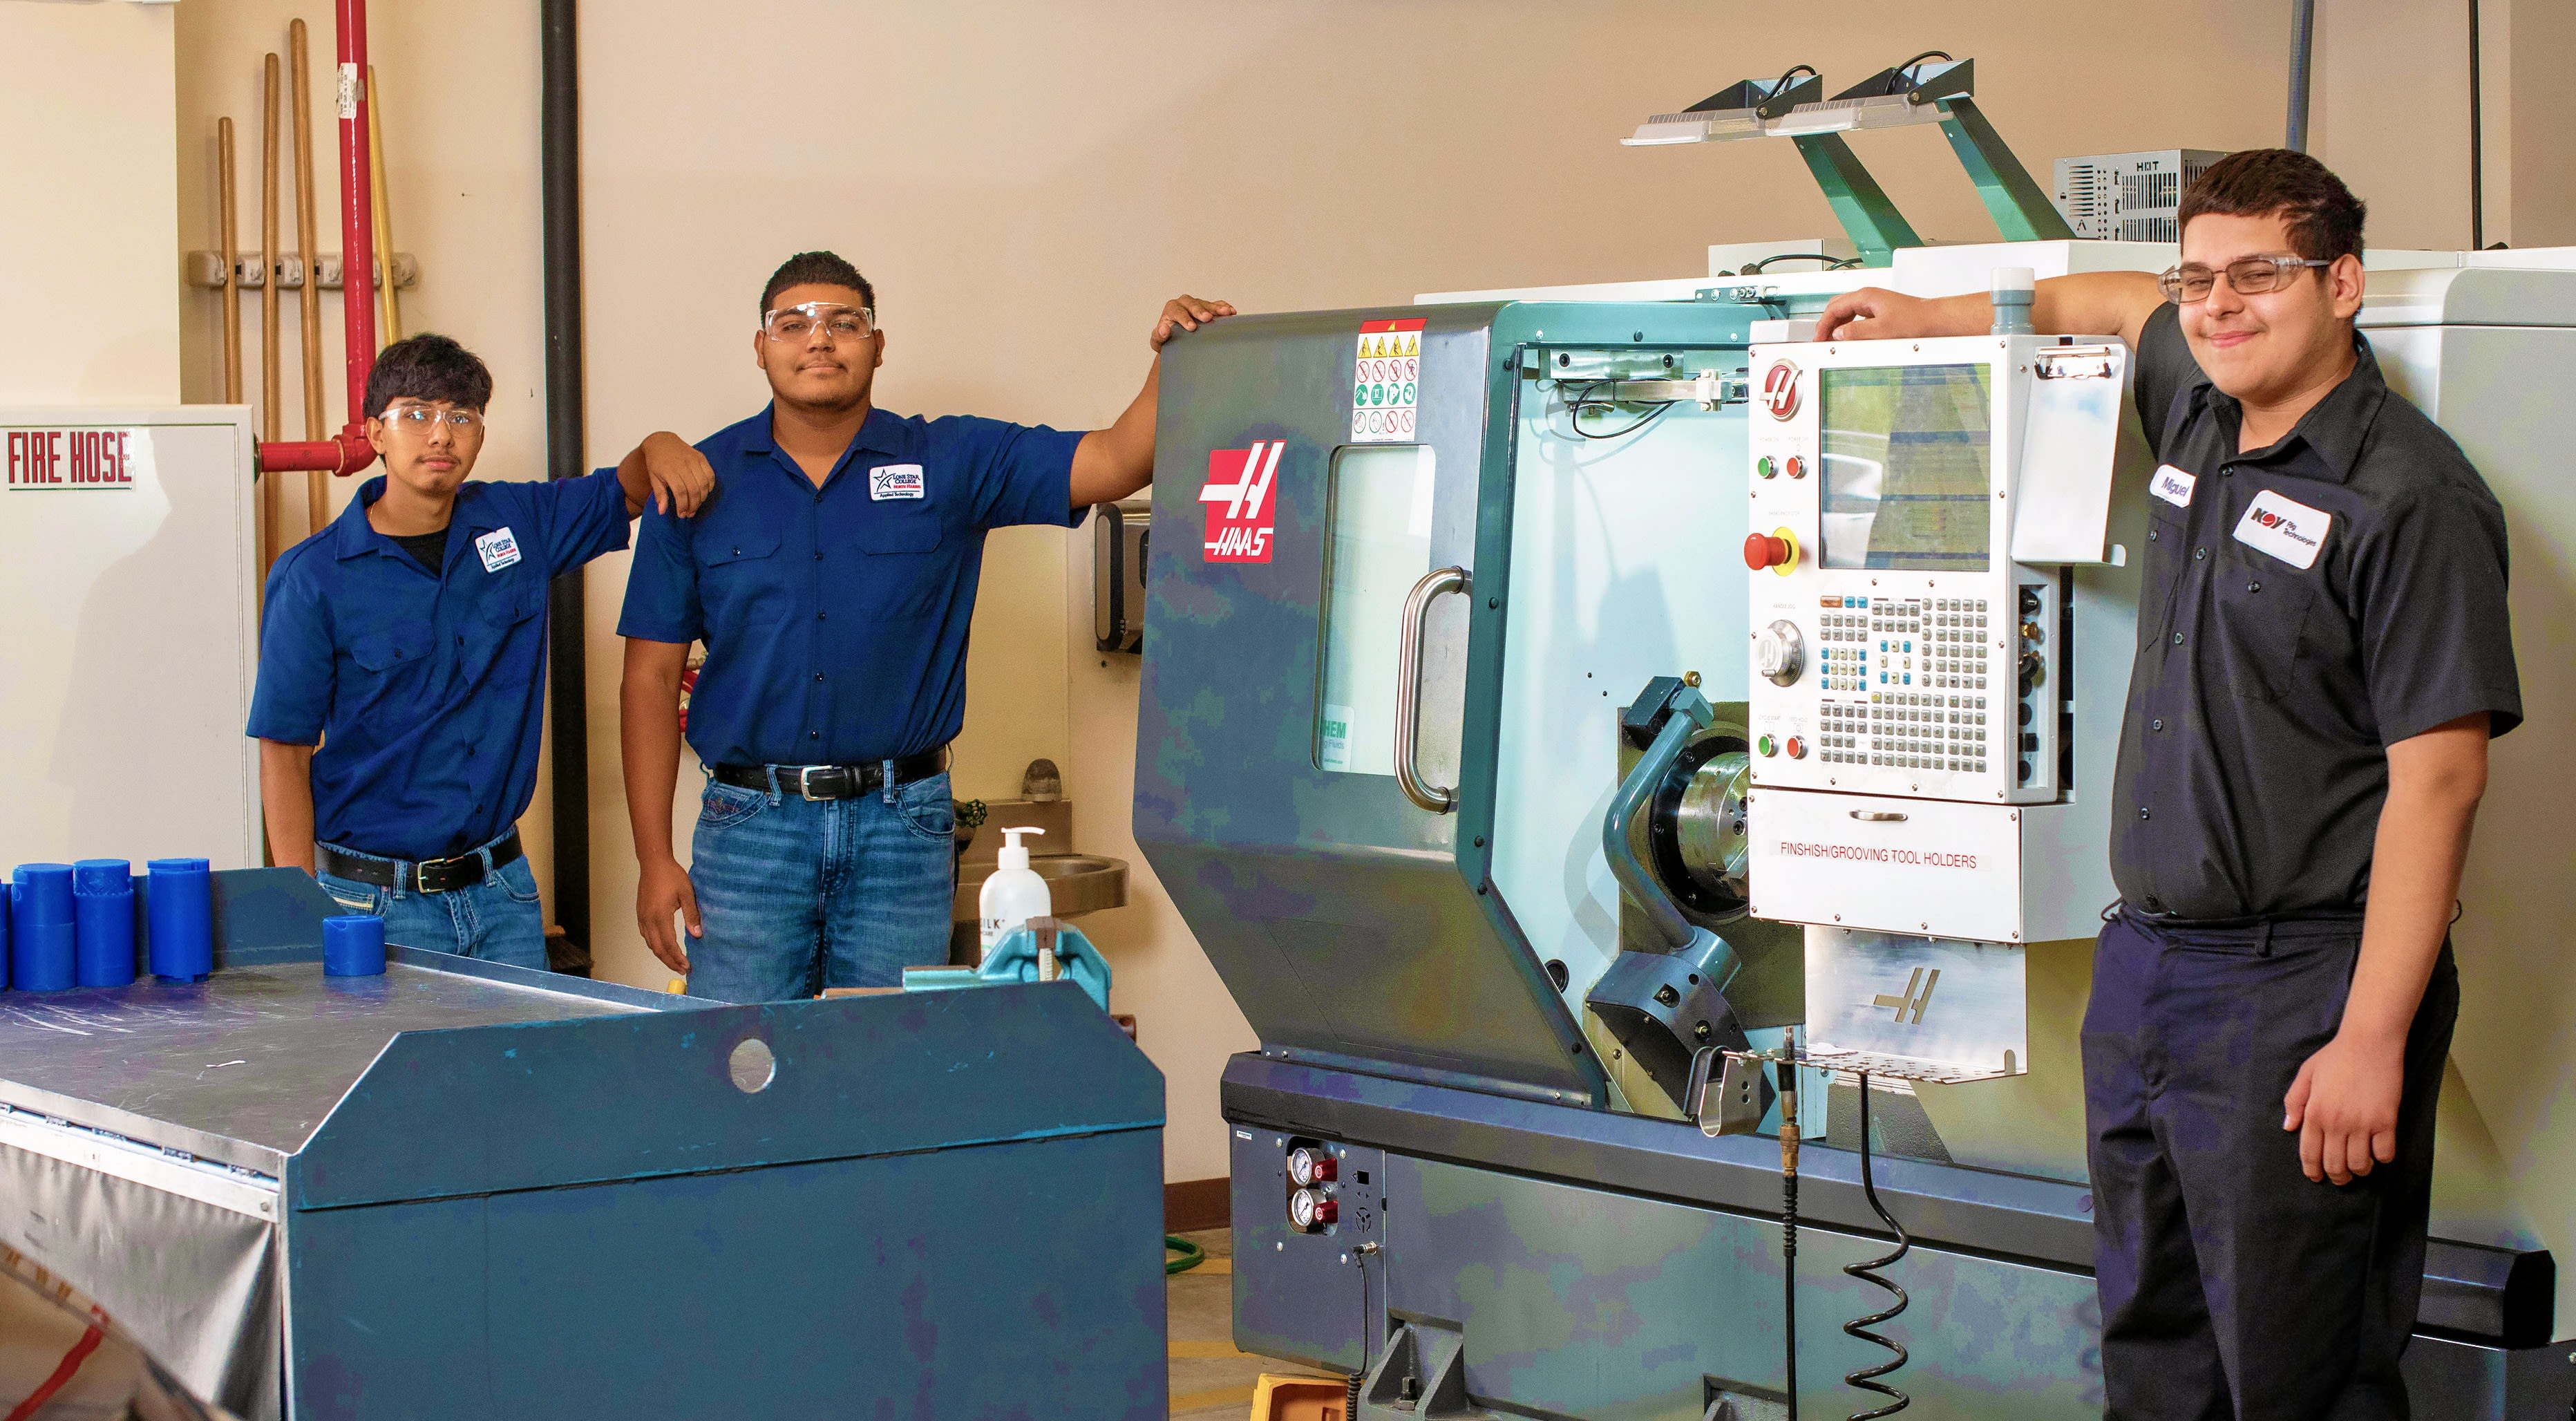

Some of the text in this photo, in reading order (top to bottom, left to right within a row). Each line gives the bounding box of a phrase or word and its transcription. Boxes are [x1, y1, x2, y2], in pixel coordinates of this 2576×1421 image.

[8, 431, 132, 483] FIRE HOSE
[2161, 476, 2190, 497] Miguel
[2283, 528, 2317, 547] Technologies
[2286, 521, 2298, 531] Rig
[1204, 527, 1273, 556] HAAS
[1781, 842, 1977, 869] FINSHISH/GROOVING TOOL HOLDERS
